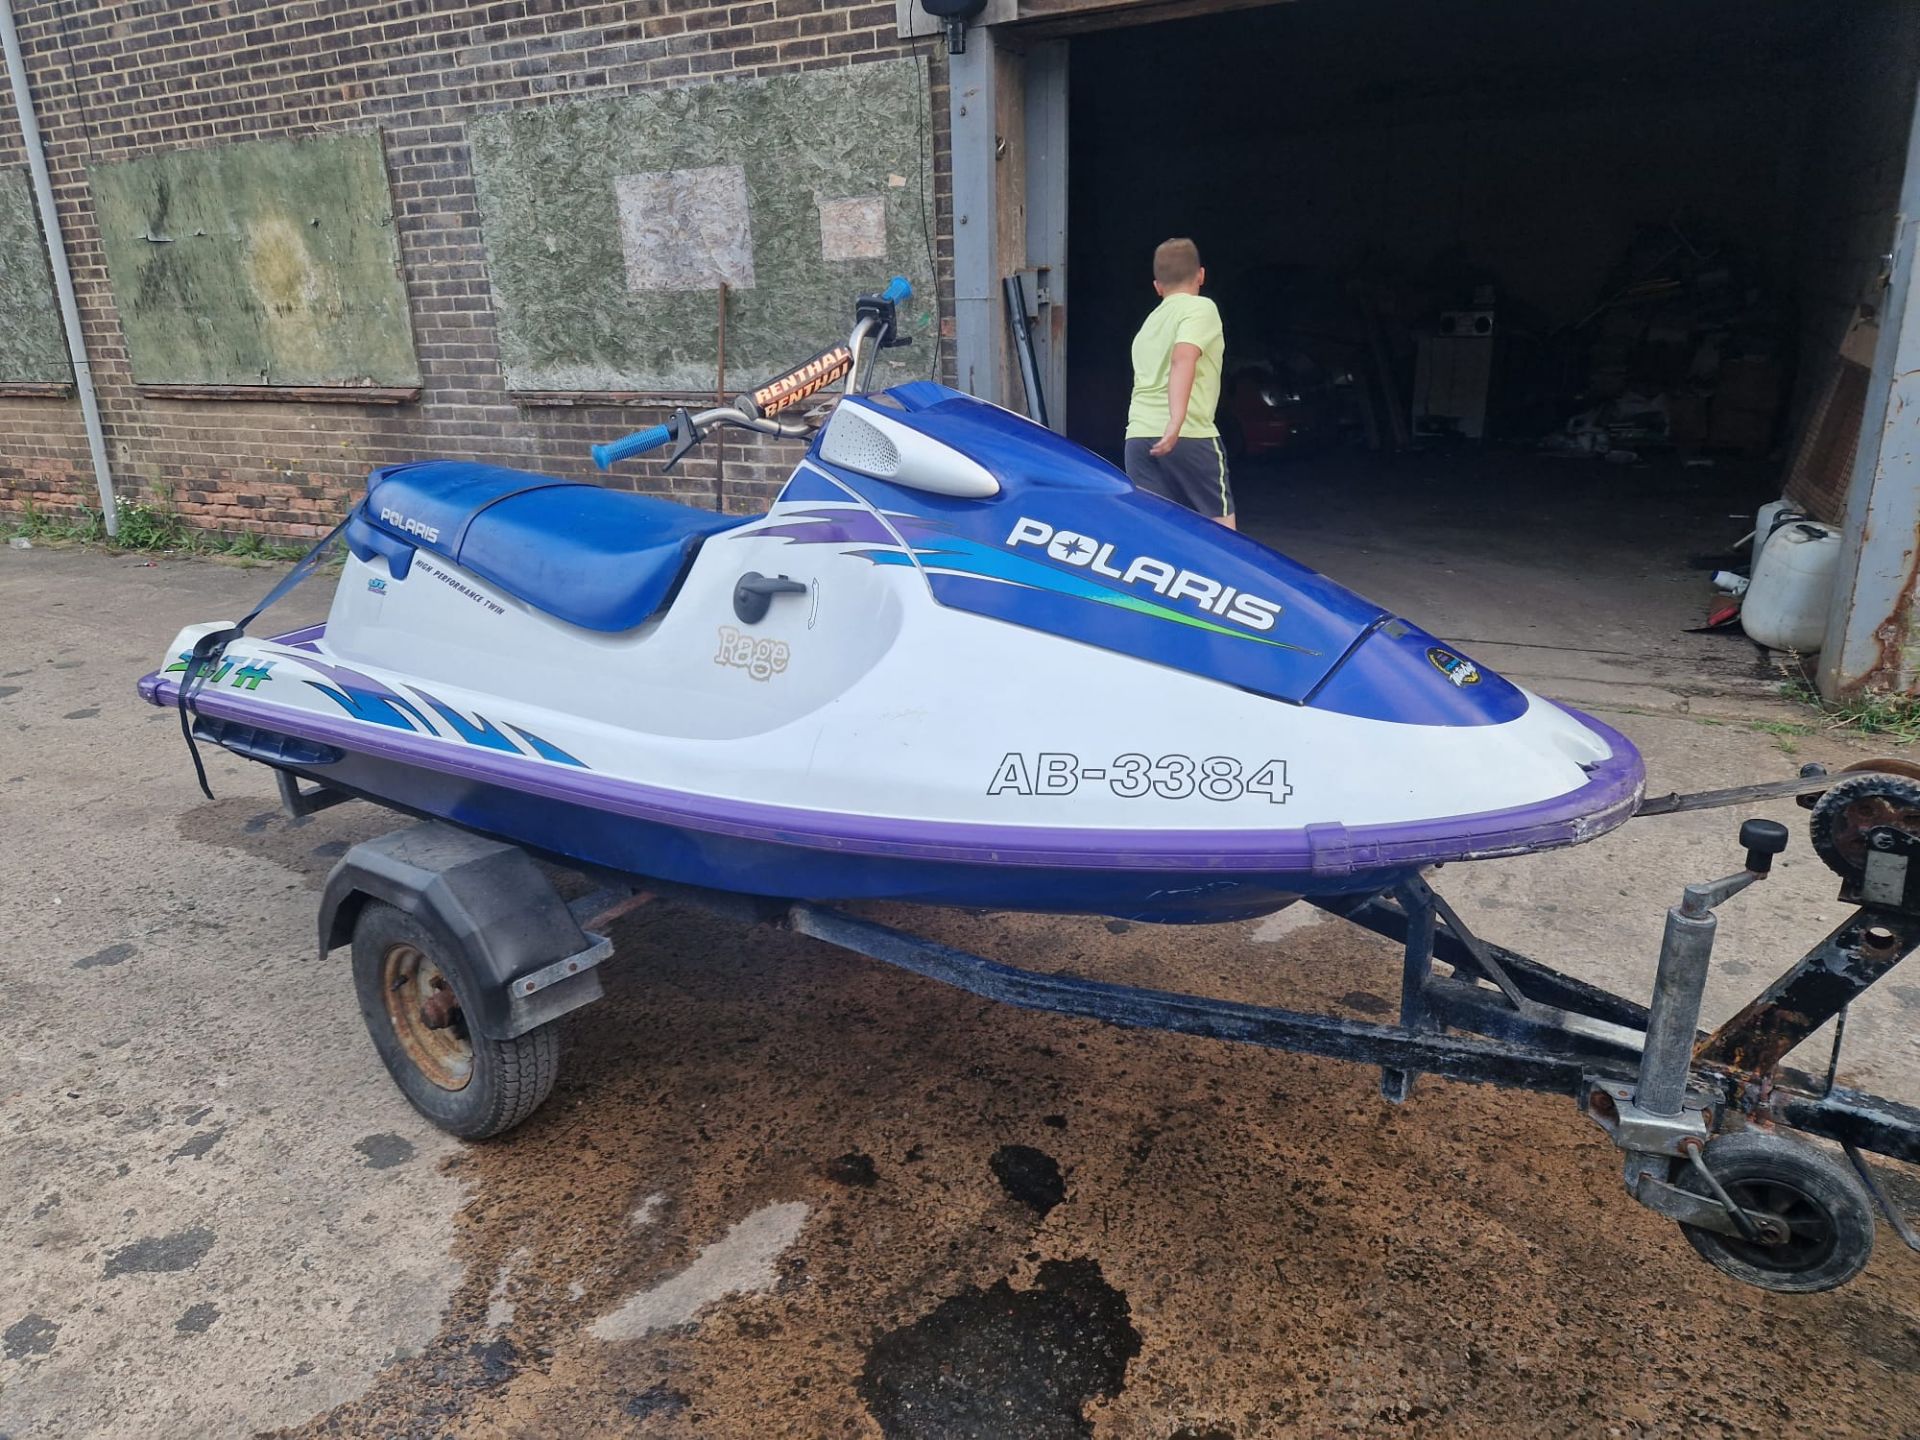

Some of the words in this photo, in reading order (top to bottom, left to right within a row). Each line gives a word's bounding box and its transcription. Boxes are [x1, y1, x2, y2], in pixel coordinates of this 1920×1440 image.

[754, 347, 850, 405] RENTHAL
[380, 507, 440, 544] POLARIS
[415, 559, 433, 573] HIGH
[433, 570, 484, 603] PERFORMANCE
[483, 600, 505, 616] TWIN
[1006, 517, 1282, 631] POLARIS
[714, 625, 790, 682] Rage
[986, 752, 1294, 804] AB-3384
